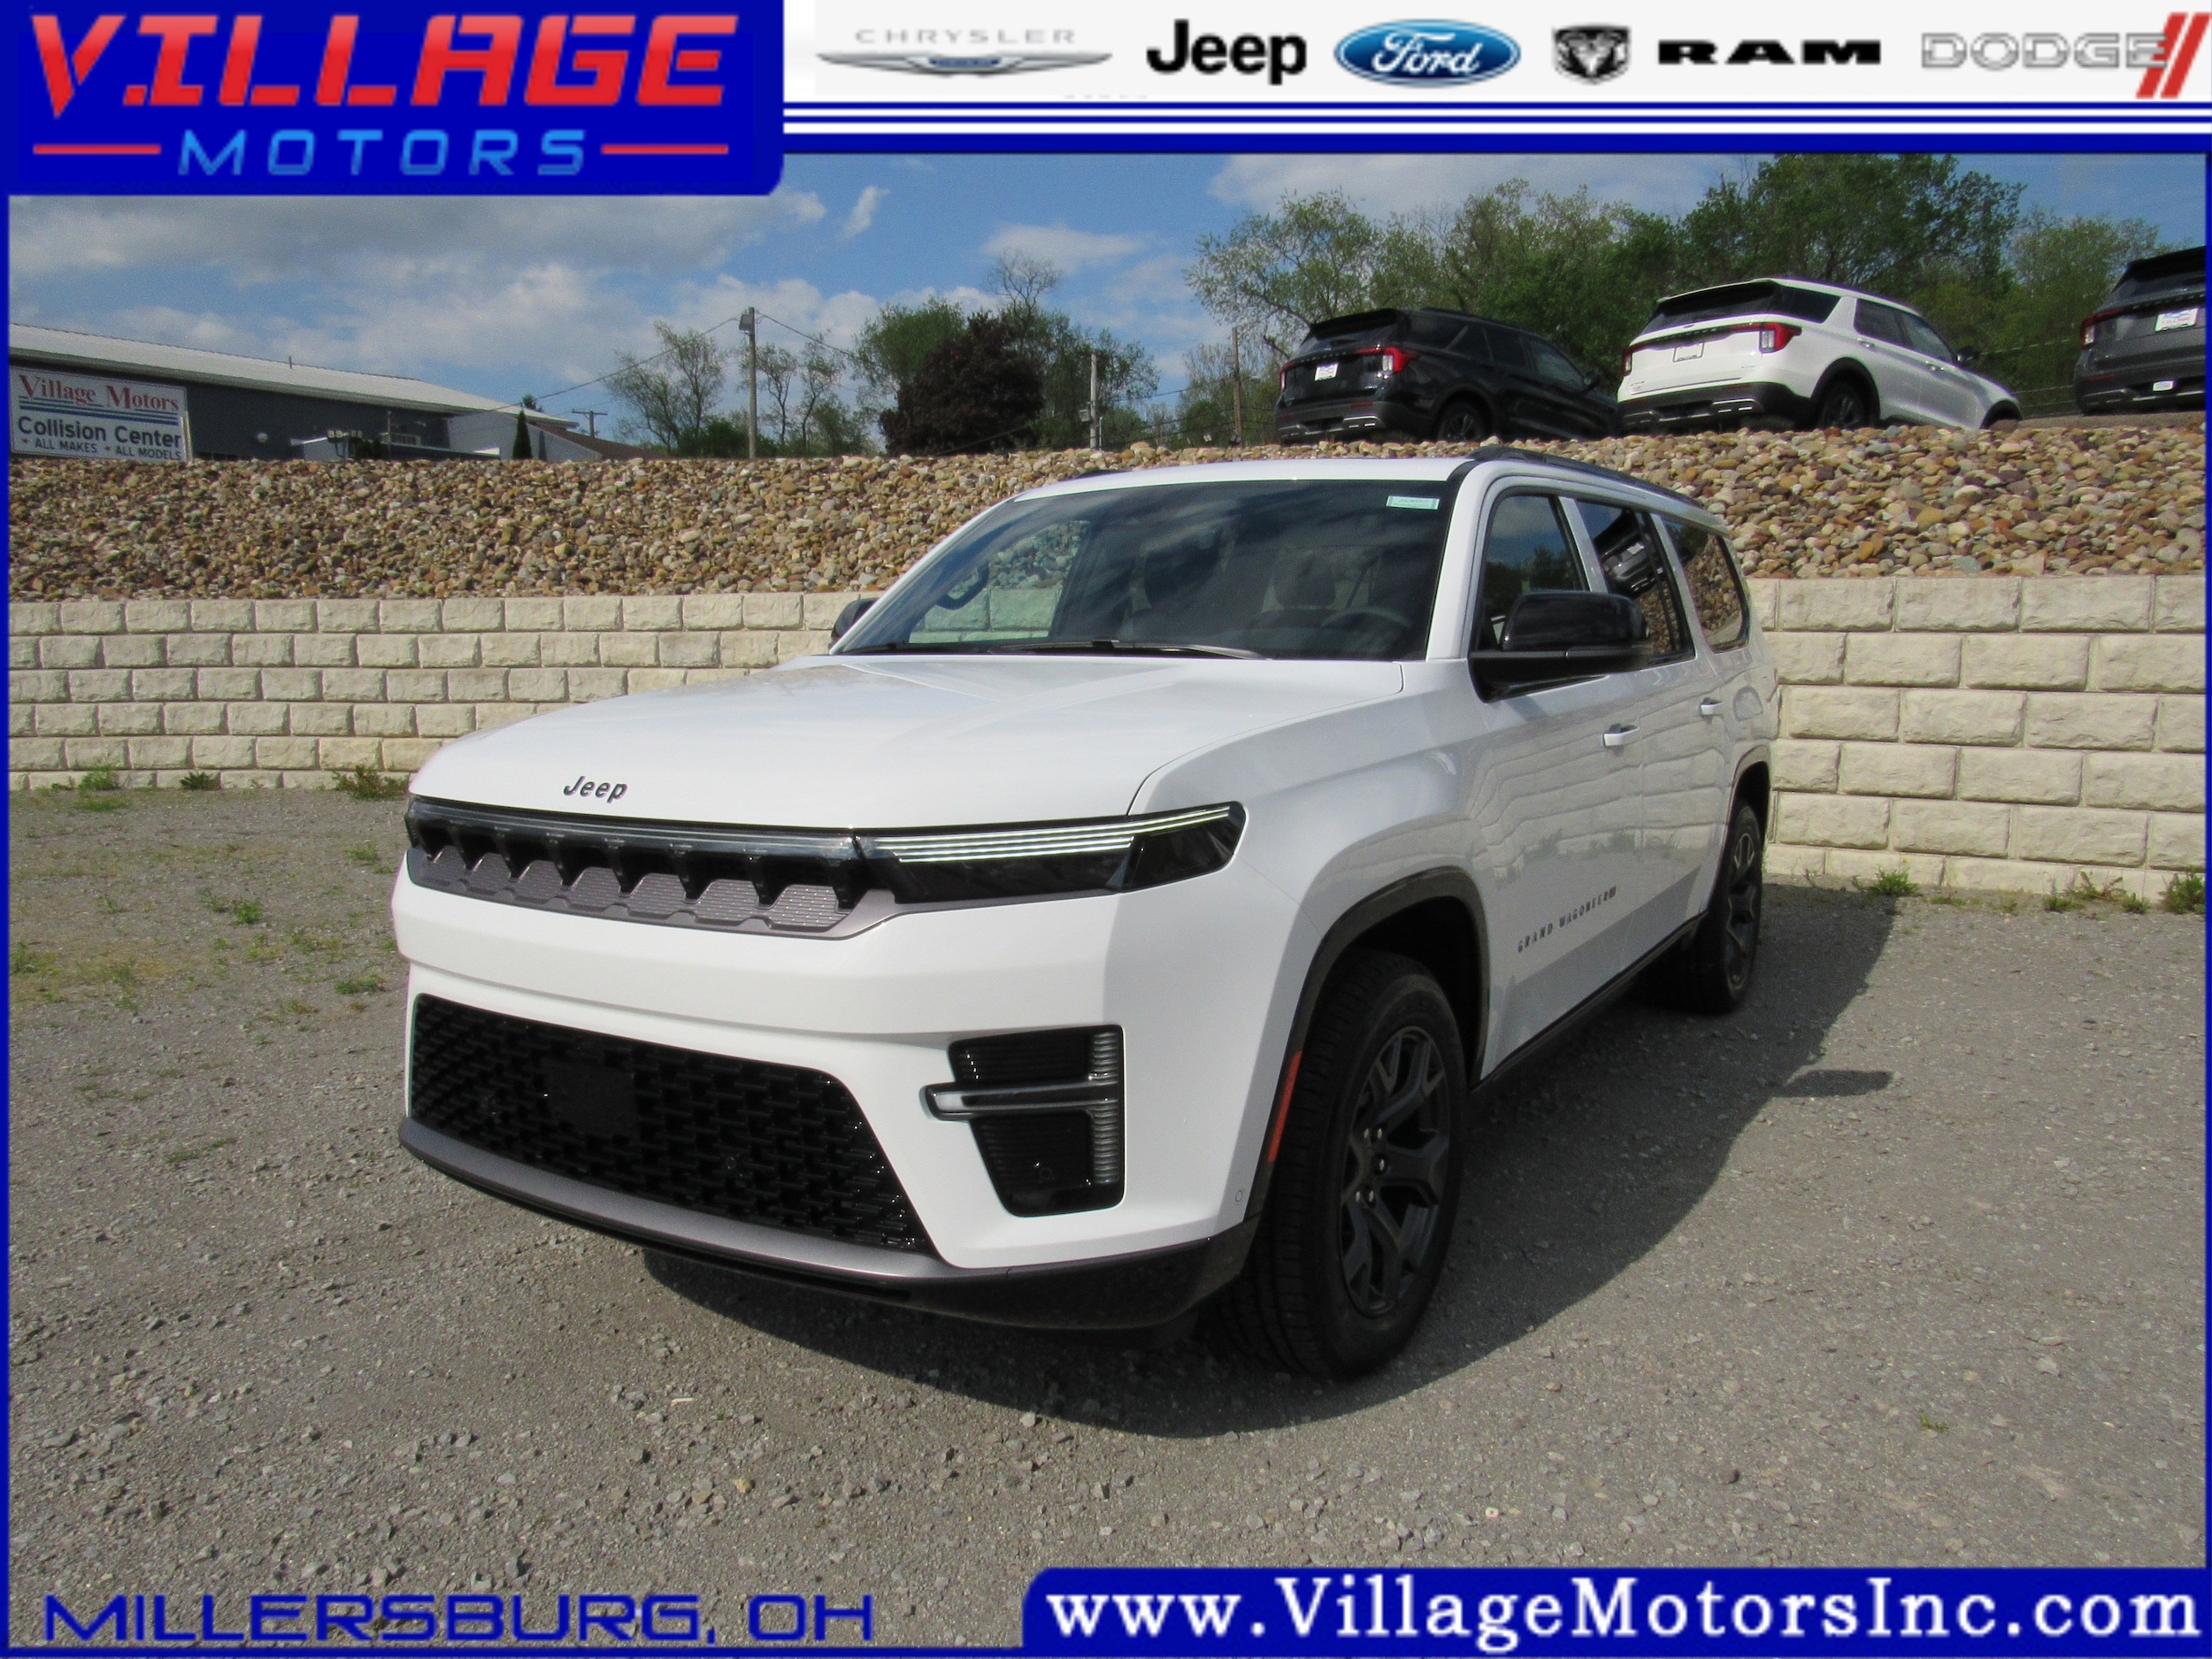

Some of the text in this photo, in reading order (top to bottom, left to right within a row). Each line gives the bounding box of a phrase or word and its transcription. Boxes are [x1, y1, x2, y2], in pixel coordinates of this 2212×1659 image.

[19, 374, 180, 411] Village Motors
[18, 416, 181, 448] Collision Center
[35, 438, 97, 453] ALL MAKES
[116, 445, 182, 461] ALL MODELS
[563, 775, 628, 803] Jeep
[1517, 890, 1609, 953] GRAND WAGONEER
